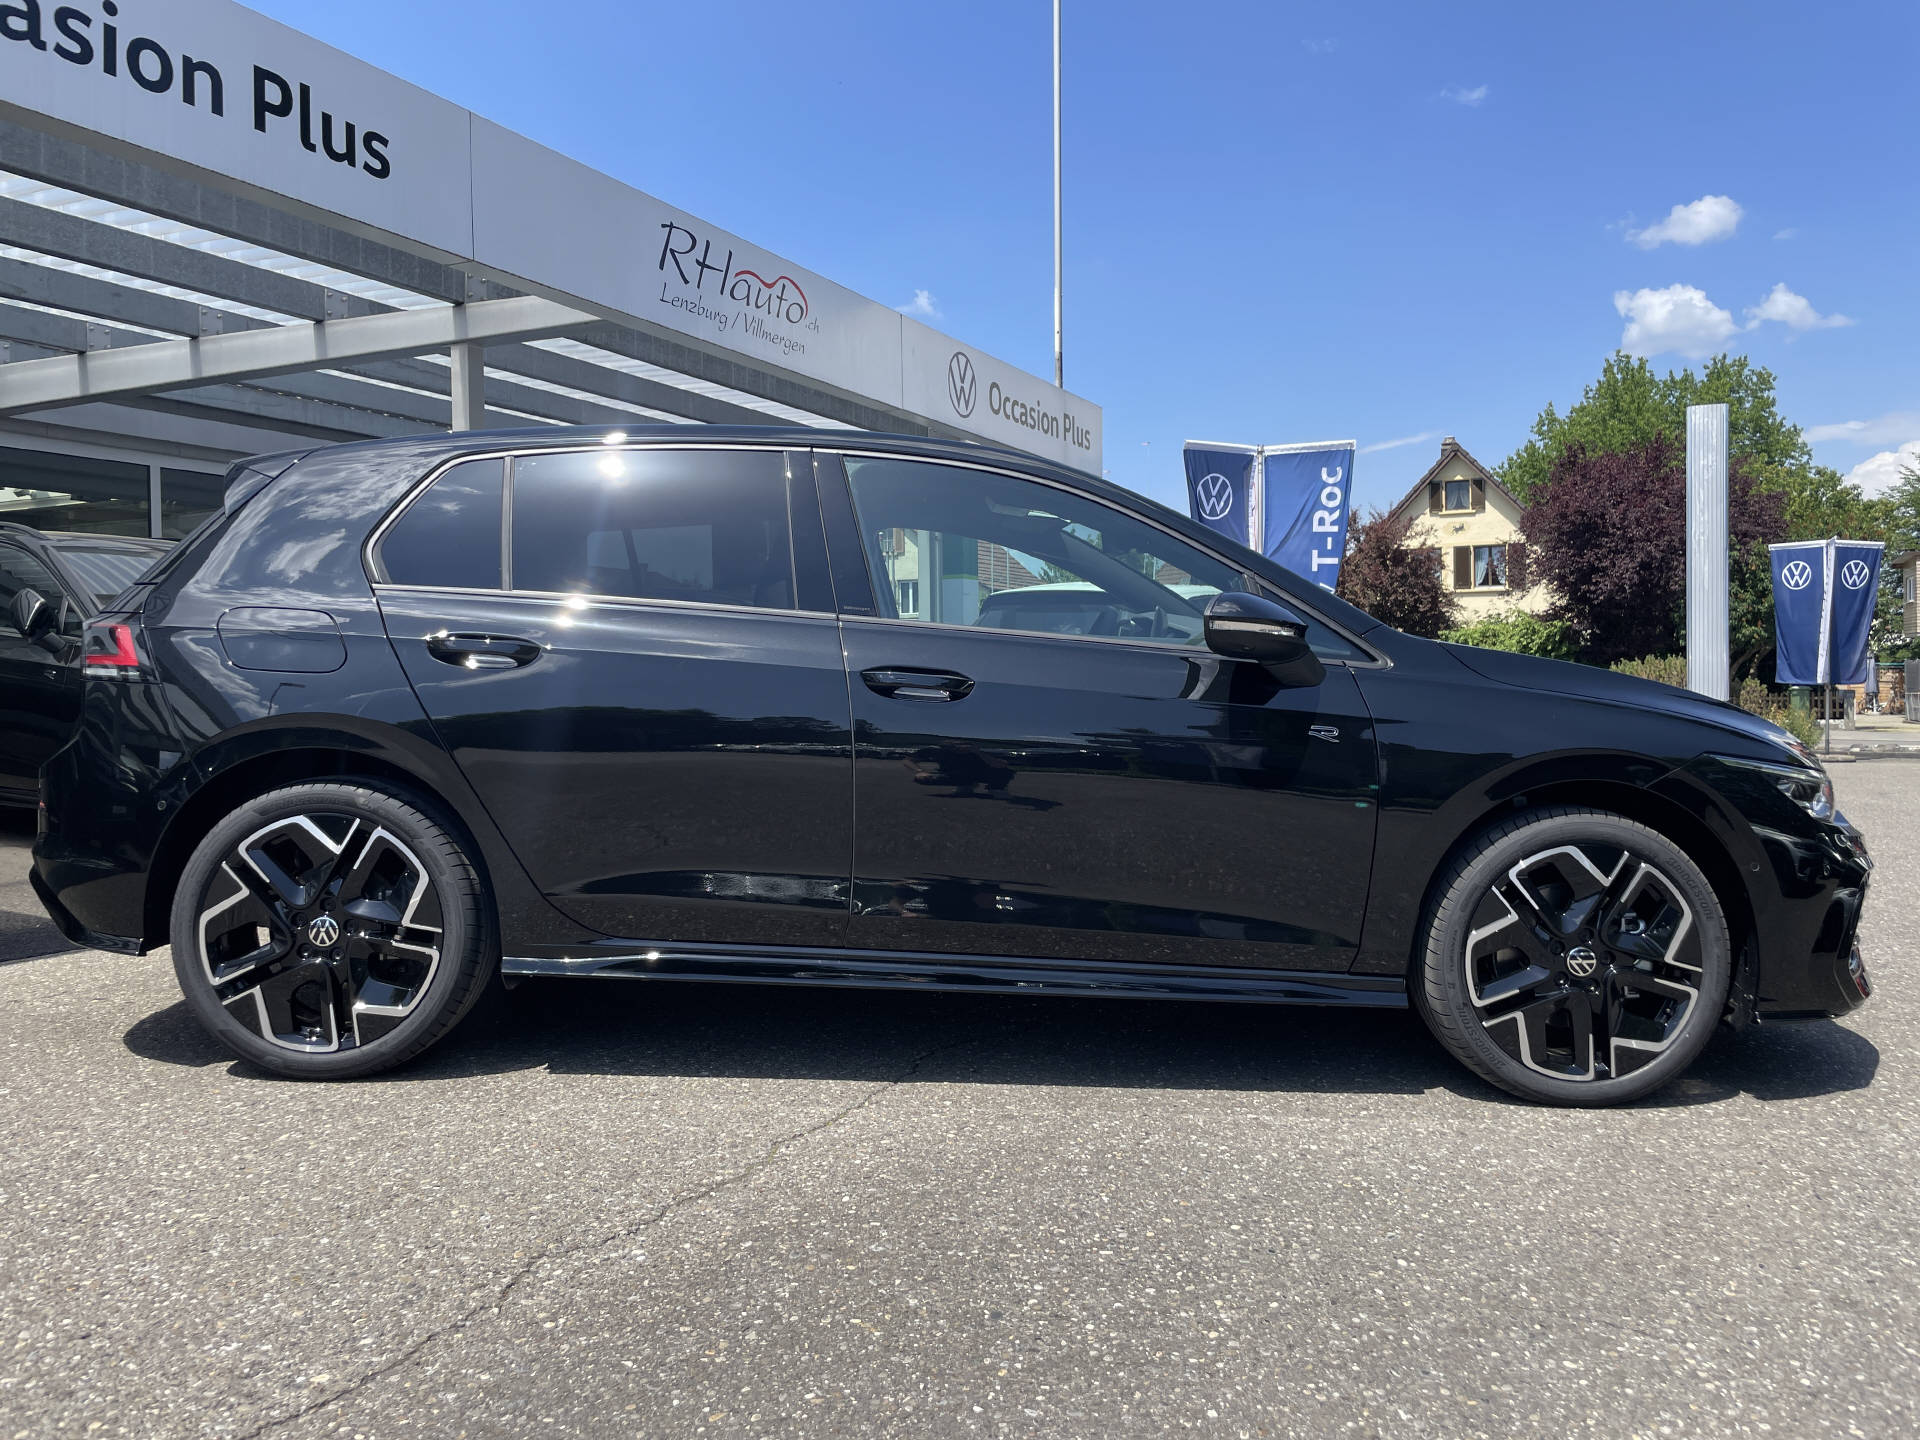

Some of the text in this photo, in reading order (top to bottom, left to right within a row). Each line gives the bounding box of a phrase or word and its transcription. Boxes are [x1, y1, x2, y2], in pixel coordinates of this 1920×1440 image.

[253, 64, 391, 180] Plus
[659, 282, 729, 331] Lenzburg
[744, 313, 806, 355] Villmergen
[988, 381, 1091, 451] Occasion Plus
